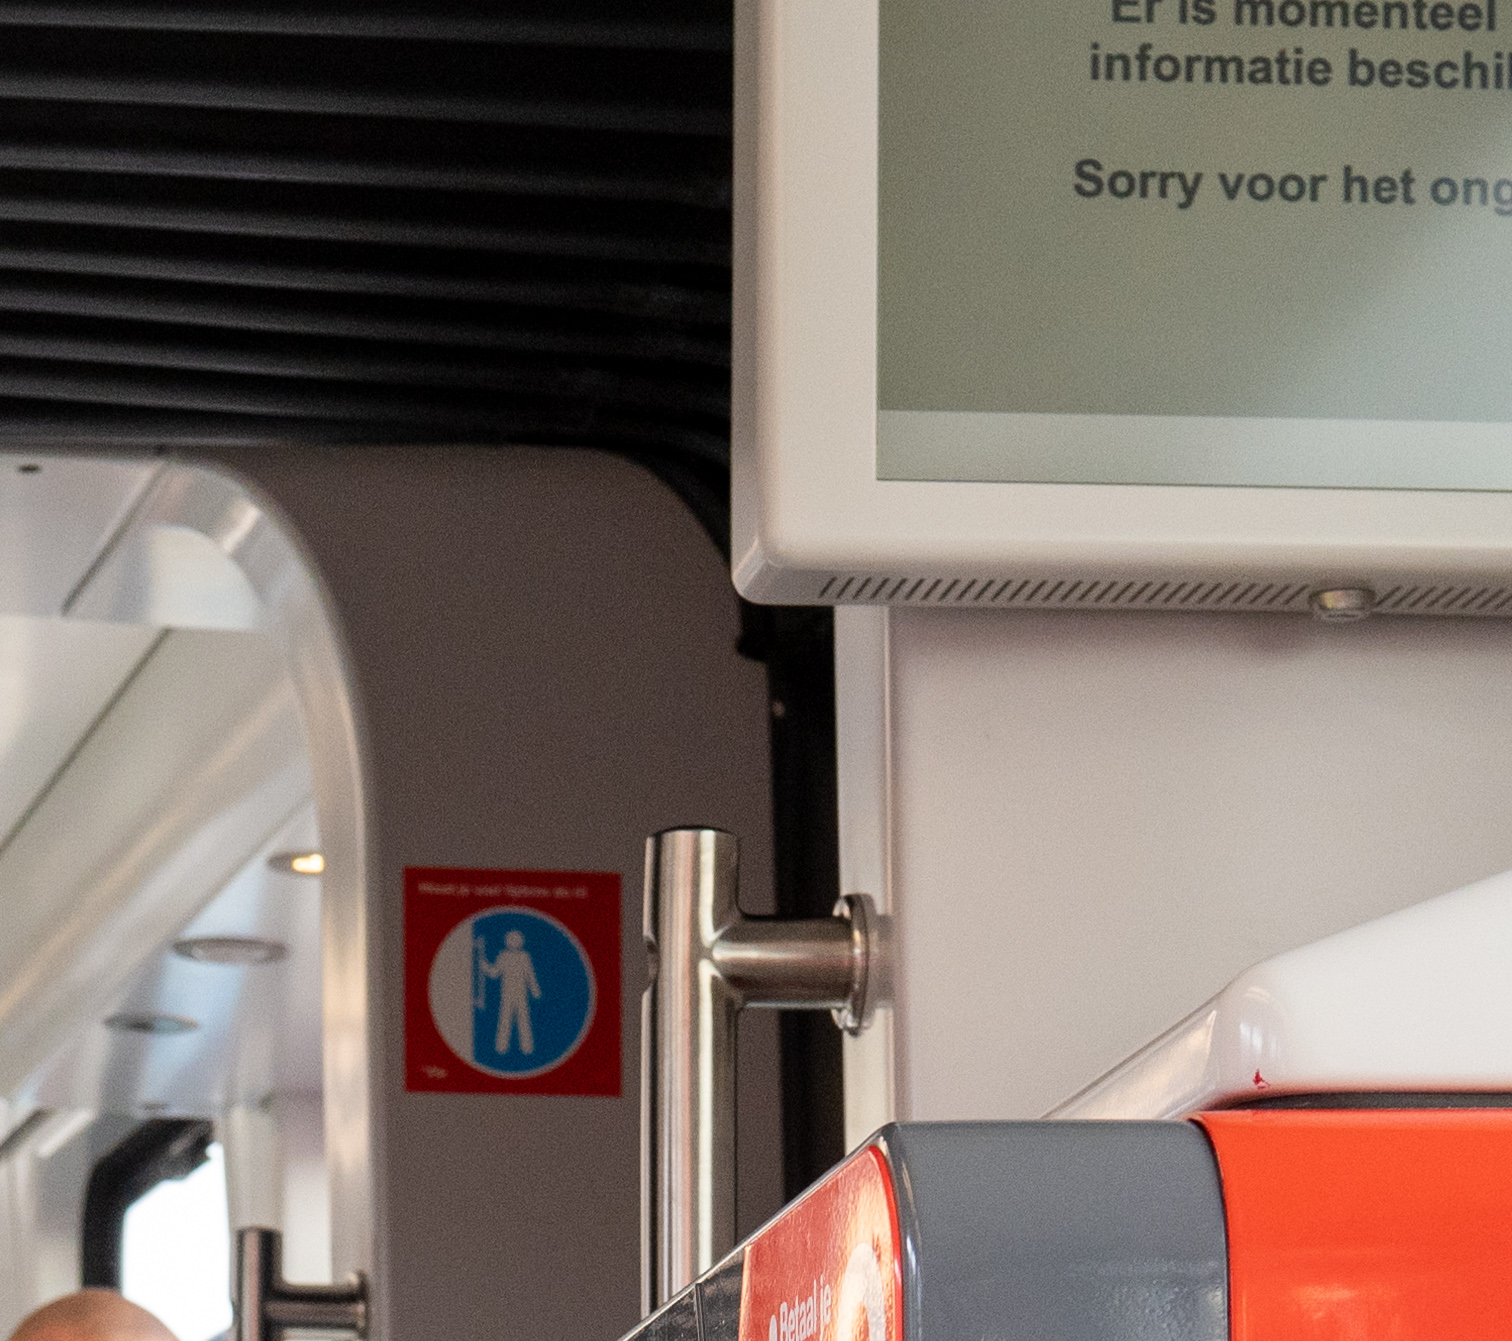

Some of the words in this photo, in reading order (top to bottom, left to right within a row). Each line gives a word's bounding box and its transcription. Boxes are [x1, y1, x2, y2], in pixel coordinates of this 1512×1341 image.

[1110, 0, 1160, 24] Er
[1179, 0, 1217, 26] is
[1233, 0, 1497, 32] momenteel
[1088, 42, 1333, 86] informatie
[1073, 157, 1203, 210] Sorry
[1218, 171, 1328, 204] voor
[1341, 163, 1417, 206] het
